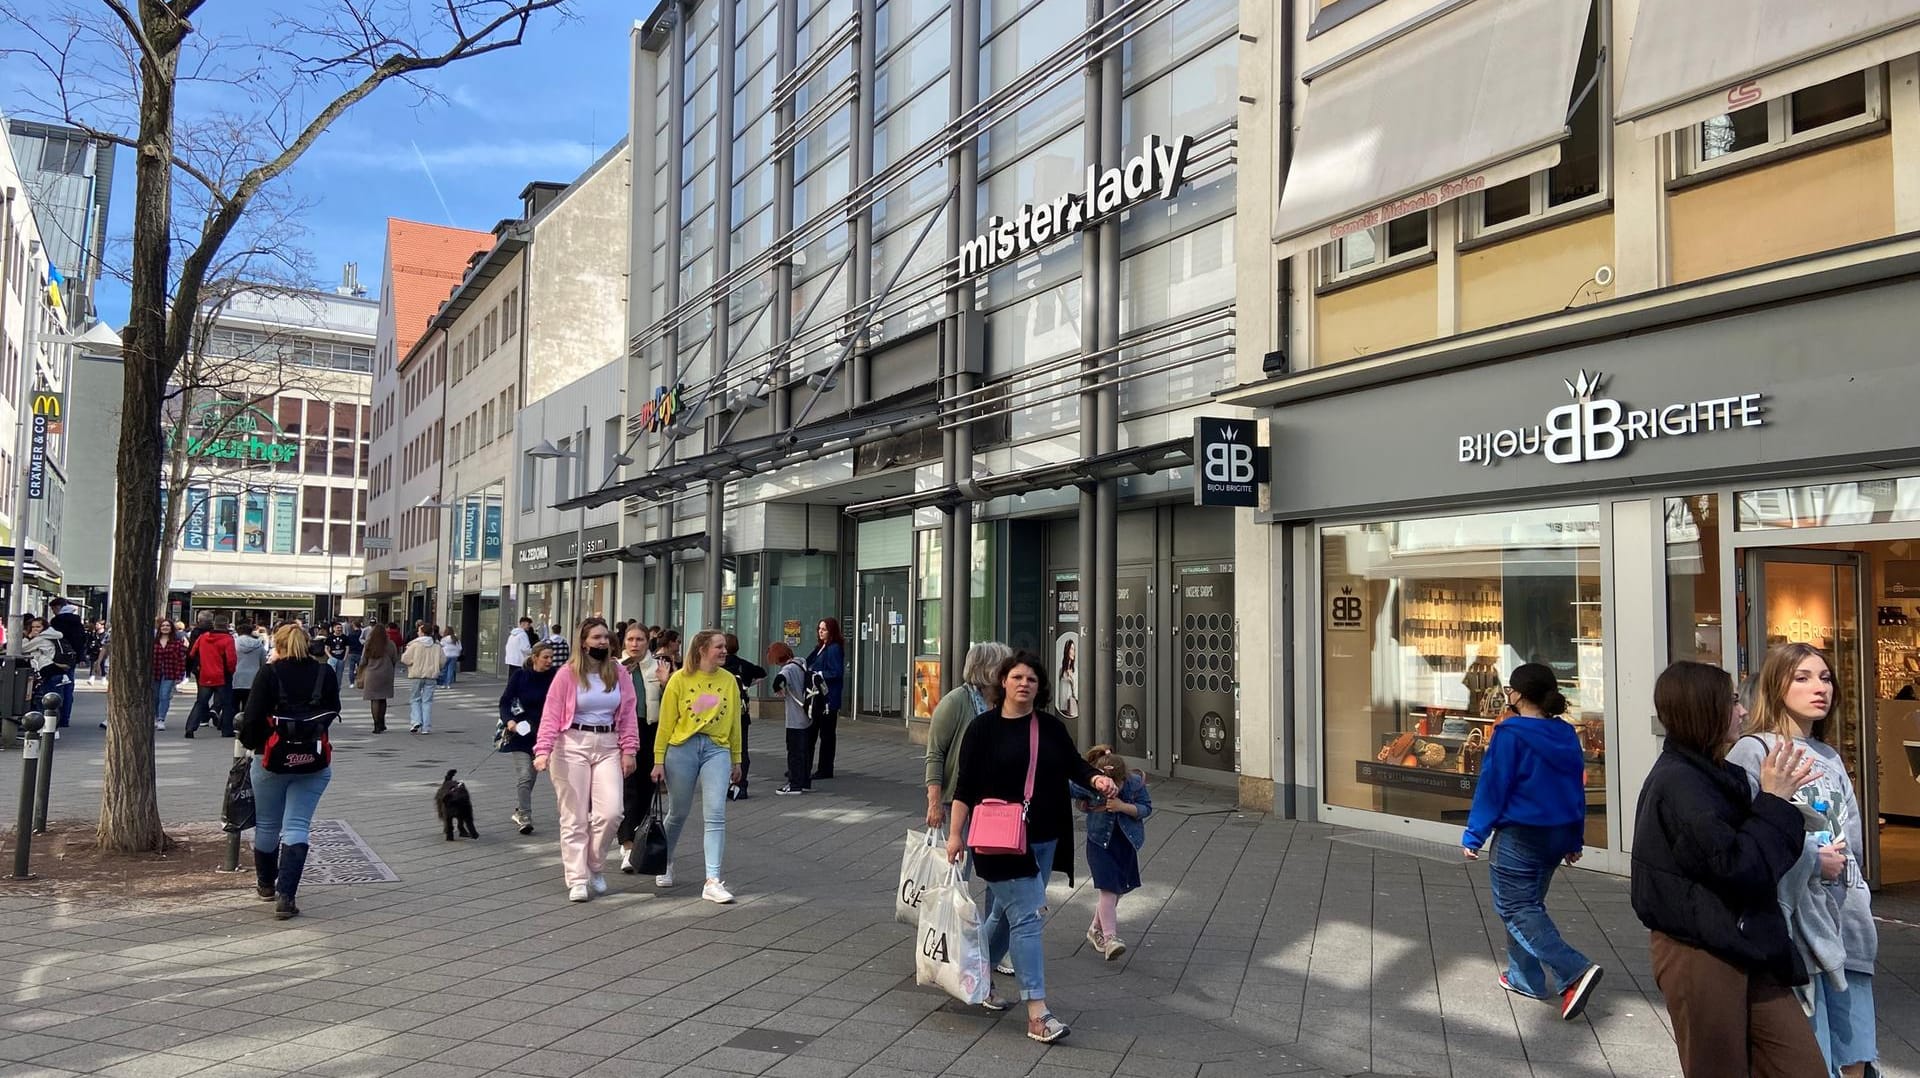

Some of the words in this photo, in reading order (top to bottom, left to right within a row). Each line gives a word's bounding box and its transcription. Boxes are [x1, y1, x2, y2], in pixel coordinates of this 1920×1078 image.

[959, 194, 1072, 277] mister
[1086, 134, 1190, 219] lady
[1330, 212, 1379, 238] Cosmetic
[1381, 191, 1438, 222] Michaela
[1440, 175, 1485, 201] Stefan
[35, 416, 45, 434] CO
[1458, 425, 1541, 467] BIJOU
[30, 448, 43, 497] CRÄMER
[1207, 483, 1225, 493] BIJOU
[1226, 484, 1253, 493] BRIGITTE
[1228, 563, 1233, 573] 2
[923, 927, 950, 963] C&A
